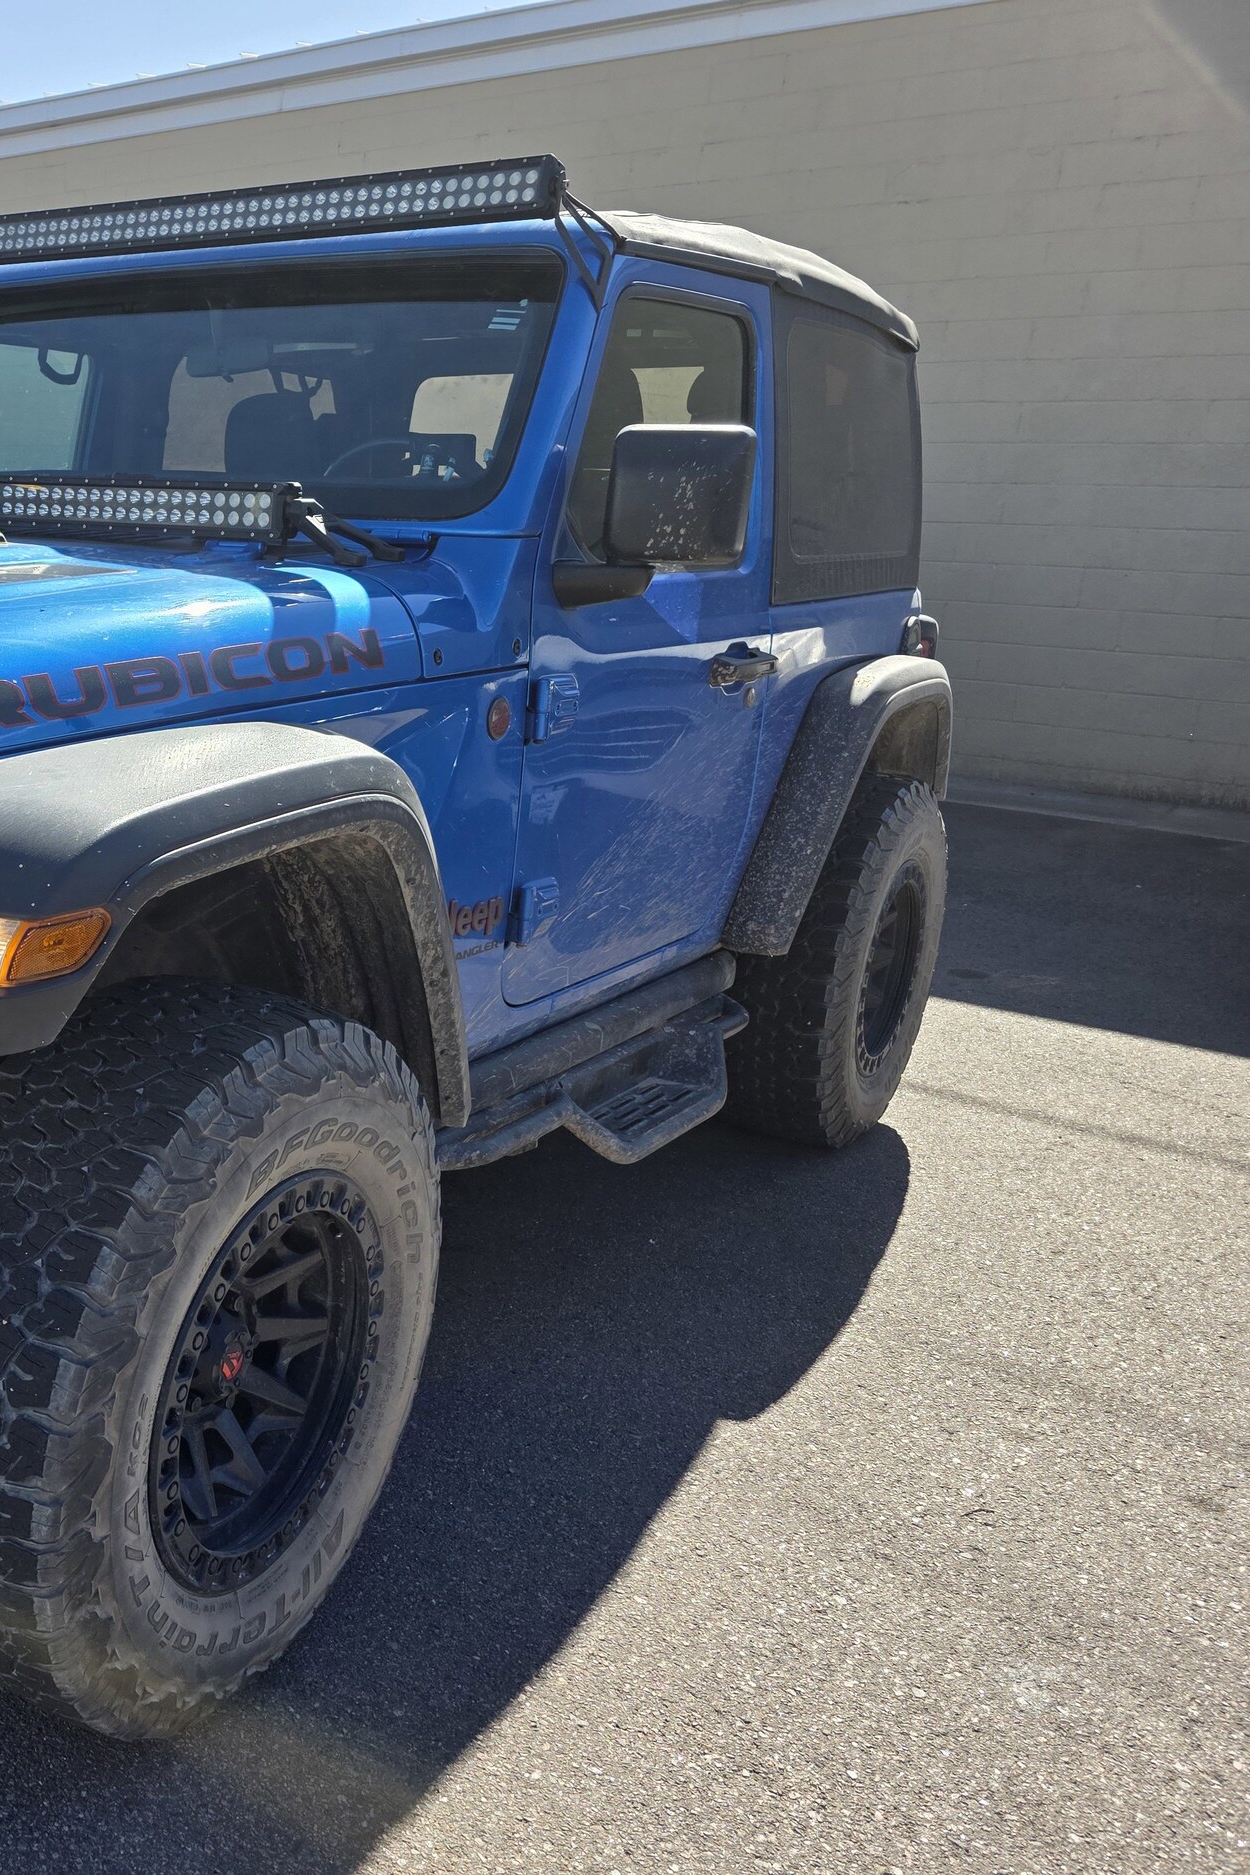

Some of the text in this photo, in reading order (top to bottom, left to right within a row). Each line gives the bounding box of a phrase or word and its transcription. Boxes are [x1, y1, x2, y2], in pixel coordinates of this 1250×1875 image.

[455, 941, 499, 960] ANGLER
[245, 1117, 425, 1264] BFGoodrich
[147, 1508, 345, 1657] All-Terrain
